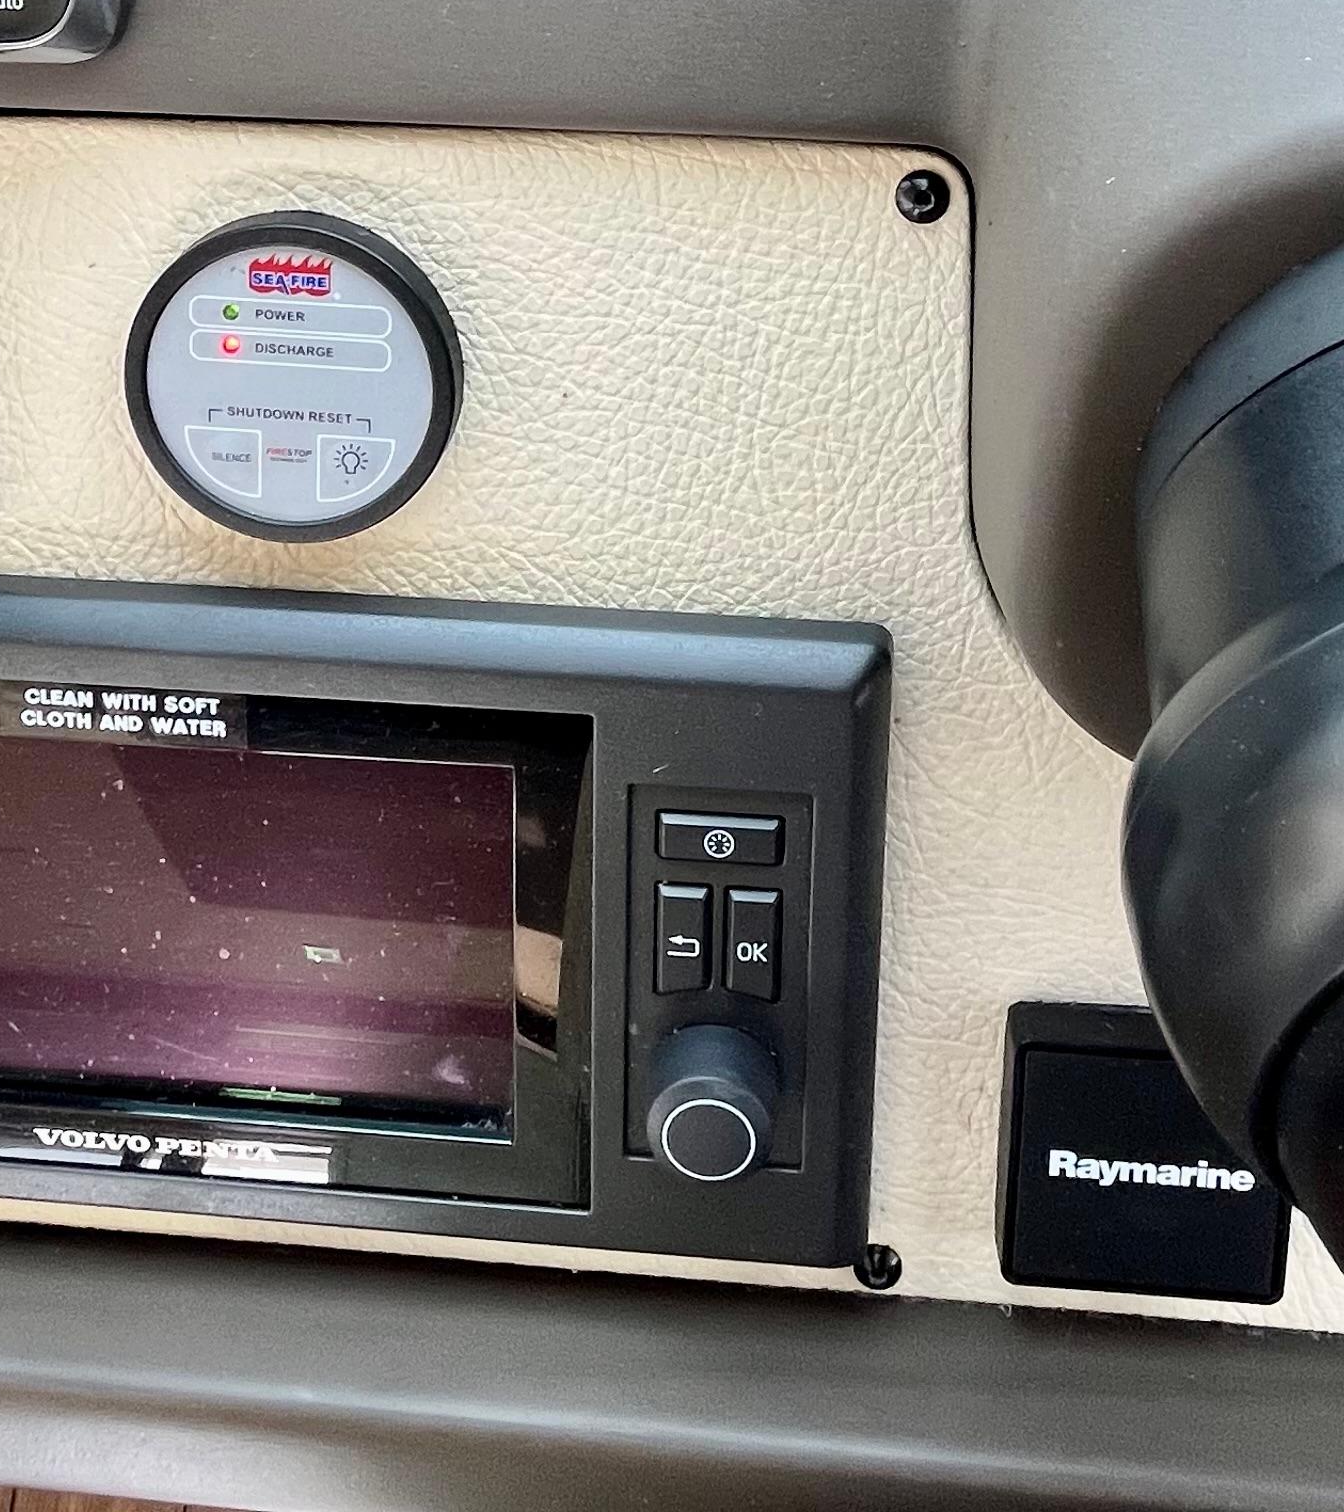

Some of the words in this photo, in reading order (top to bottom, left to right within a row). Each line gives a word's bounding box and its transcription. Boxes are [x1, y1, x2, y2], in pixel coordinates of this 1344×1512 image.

[255, 308, 306, 322] POWER
[255, 342, 335, 358] DISCHARGE
[227, 406, 305, 422] SHUTDOWN
[308, 410, 353, 425] RESET
[23, 688, 94, 709] CLEAN
[101, 692, 157, 713] WITH
[164, 696, 221, 716] SOFT
[20, 710, 93, 730] CLOTH
[99, 714, 144, 733] AND
[151, 717, 228, 739] WATER
[737, 942, 768, 962] OK
[33, 1128, 151, 1154] VOLVO
[155, 1136, 280, 1163] PENTA
[1048, 1149, 1256, 1192] Raymarine
